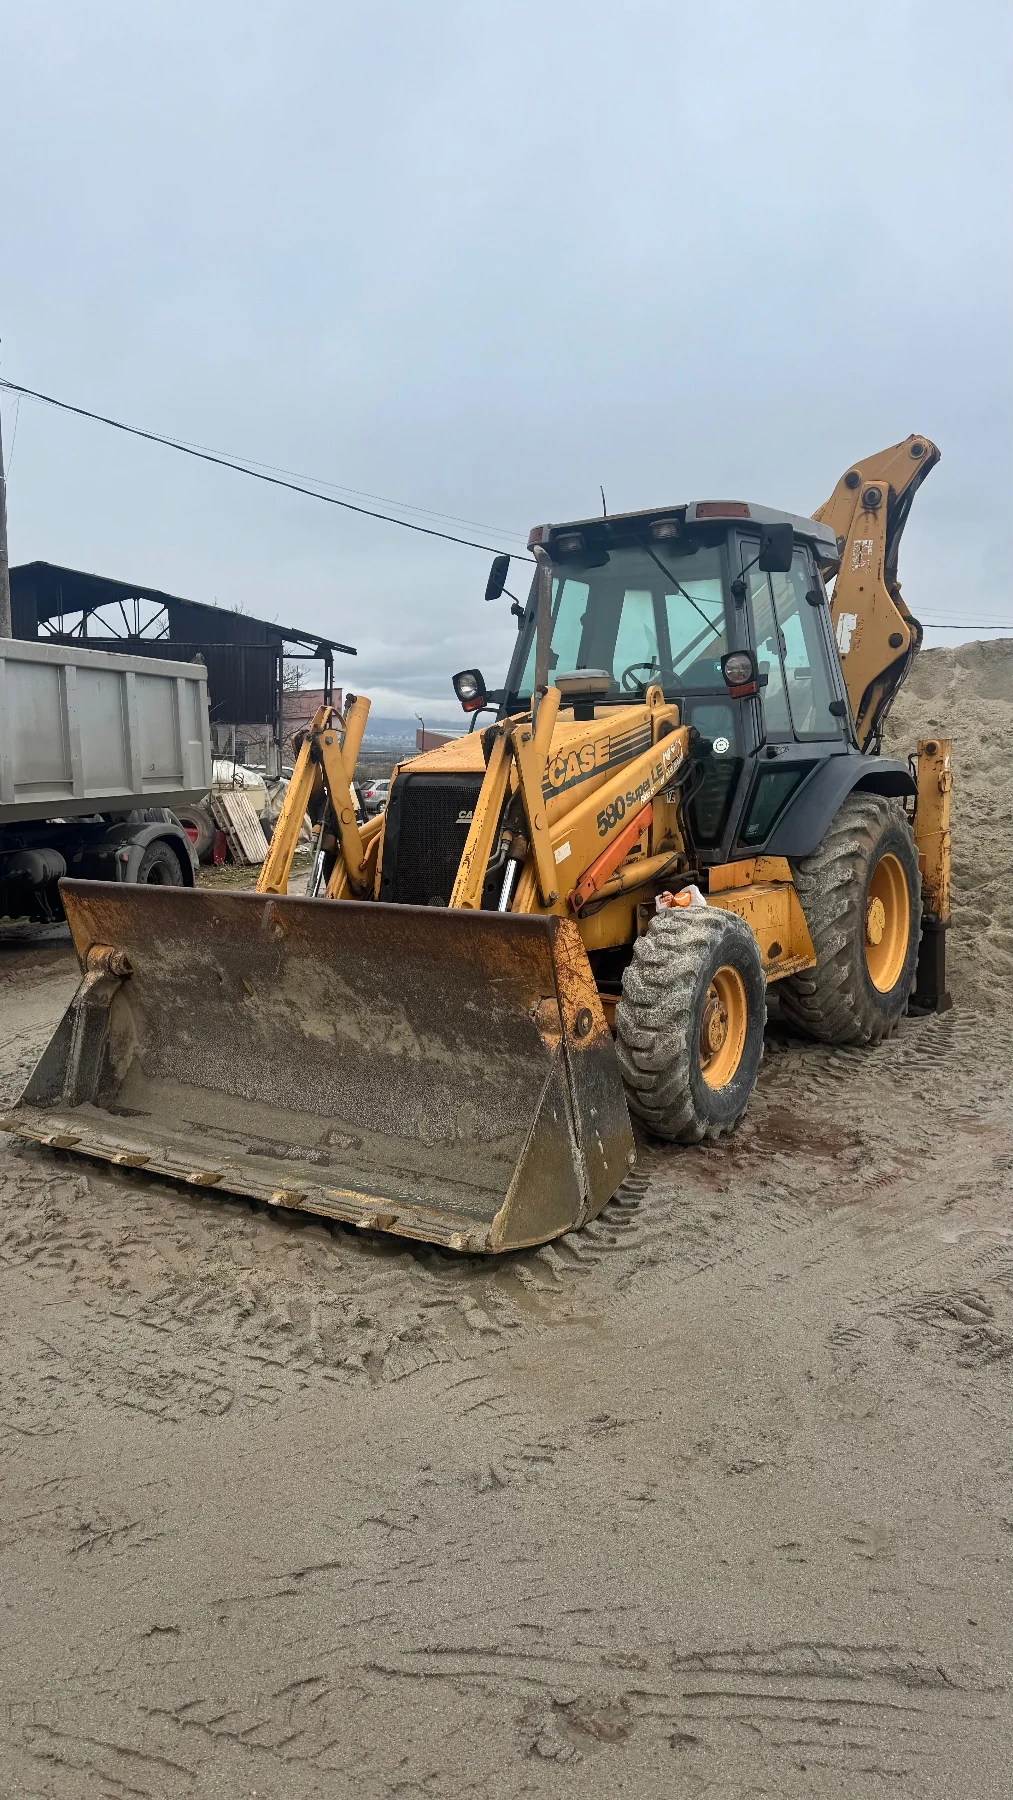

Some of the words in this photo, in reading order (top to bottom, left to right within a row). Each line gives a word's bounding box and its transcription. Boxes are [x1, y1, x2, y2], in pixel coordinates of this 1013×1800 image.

[548, 735, 611, 788] CASE
[458, 810, 473, 819] CA
[597, 796, 625, 837] 580
